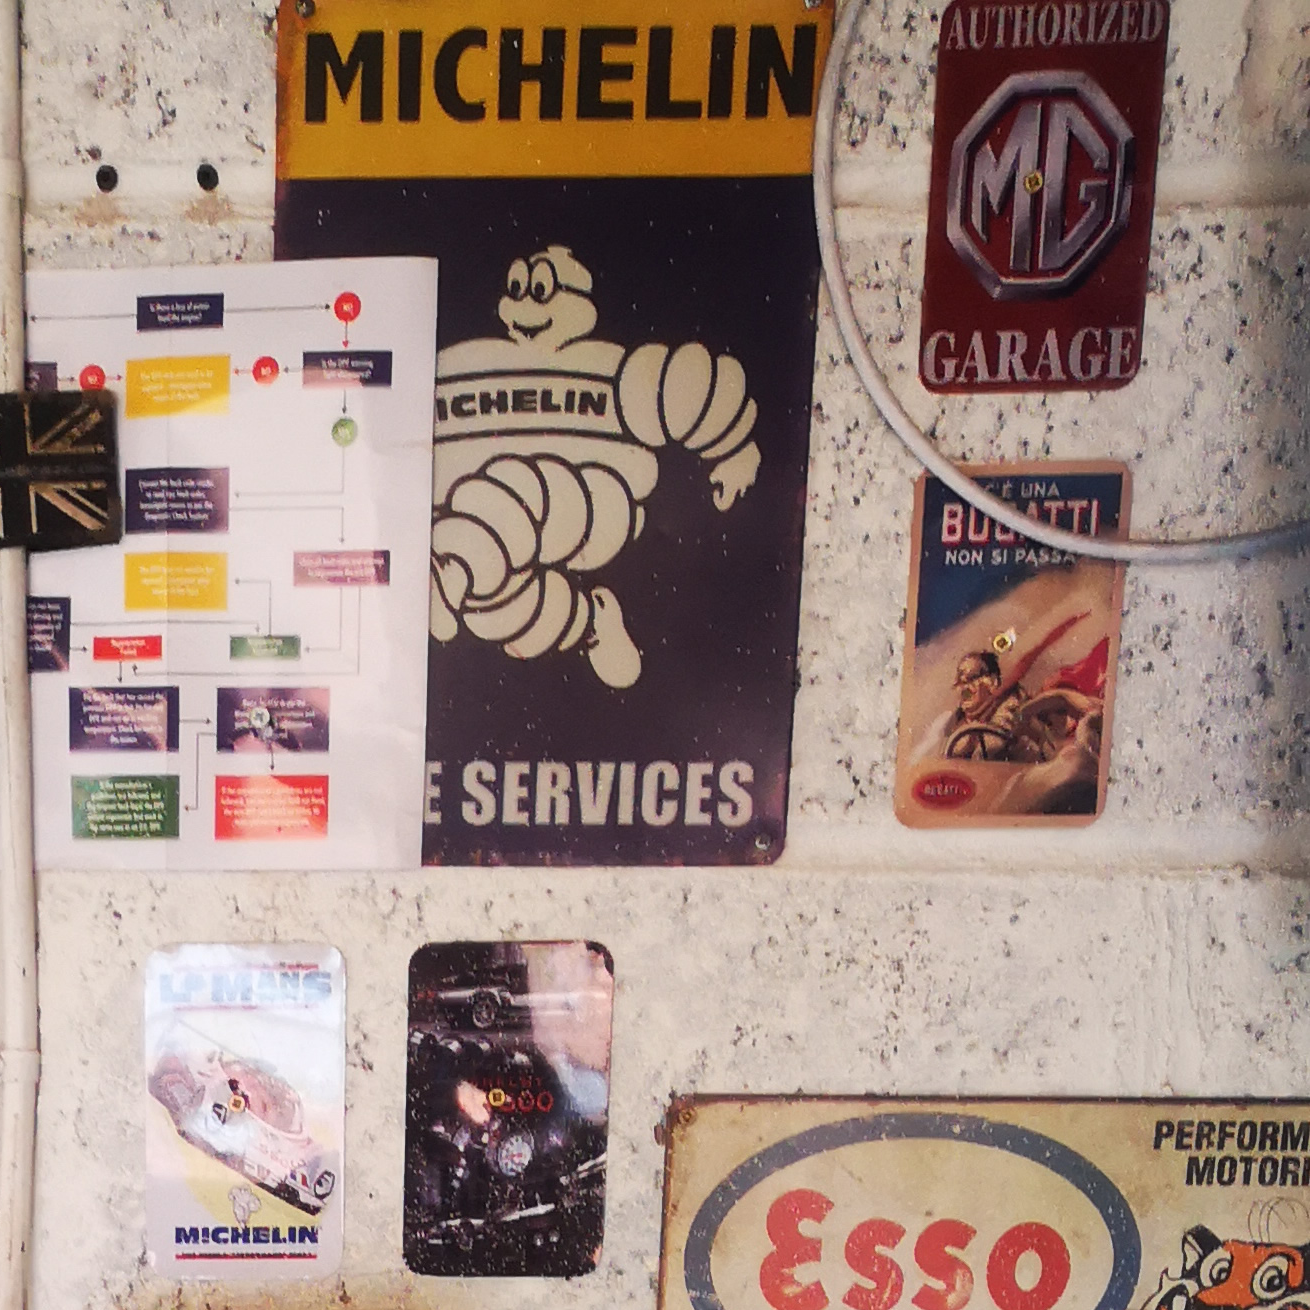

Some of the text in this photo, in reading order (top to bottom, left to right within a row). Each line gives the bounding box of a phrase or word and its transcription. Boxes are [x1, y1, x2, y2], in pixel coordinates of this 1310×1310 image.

[945, 0, 1165, 50] AUTHORIZED
[304, 23, 818, 124] MICHELIN
[970, 101, 1111, 273] MG
[921, 325, 1137, 385] GARAGE
[437, 388, 607, 421] ICHELIN
[944, 548, 984, 567] NON
[990, 547, 1008, 566] SI
[460, 758, 755, 829] SERVICES
[174, 1225, 319, 1245] MICHELIN
